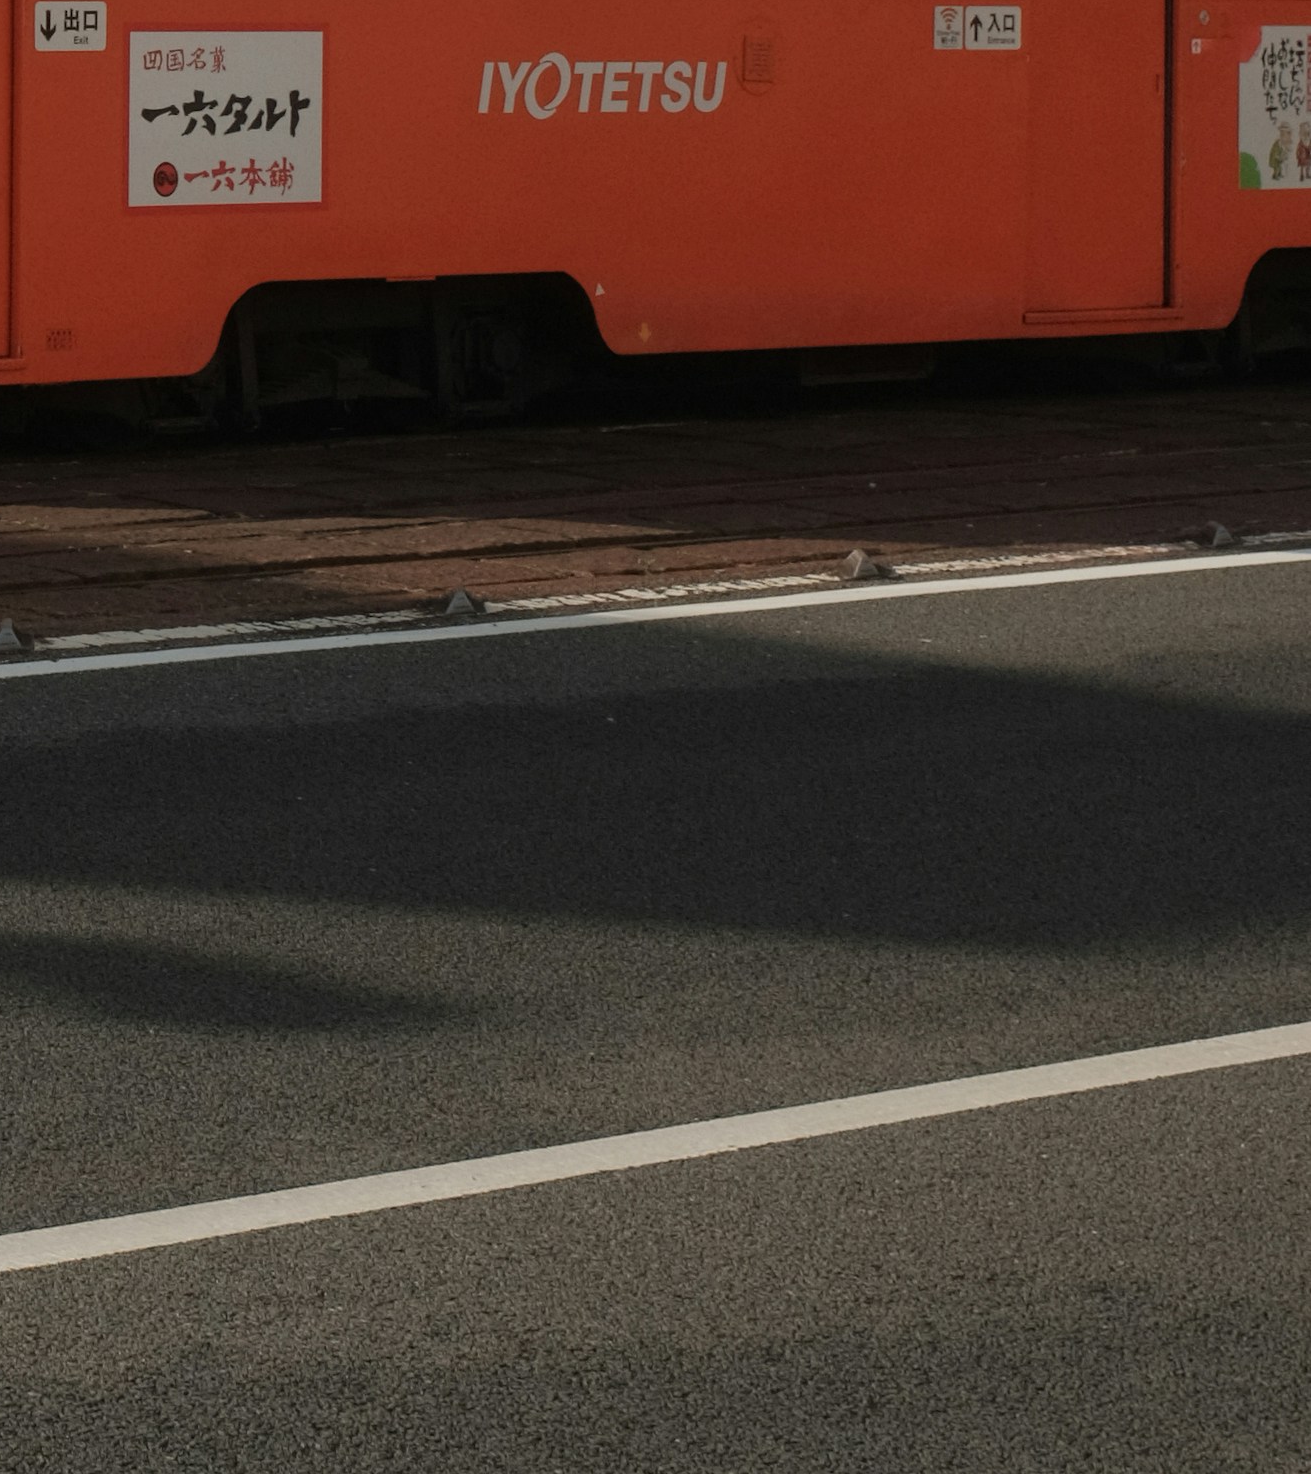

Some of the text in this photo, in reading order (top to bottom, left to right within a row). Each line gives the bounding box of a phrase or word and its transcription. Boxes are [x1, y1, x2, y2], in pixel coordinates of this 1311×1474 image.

[64, 8, 98, 32] 出口
[988, 13, 1015, 33] 入口
[73, 35, 89, 45] Exit
[478, 52, 727, 120] IYOTETSU
[141, 90, 310, 137] 一六タルト
